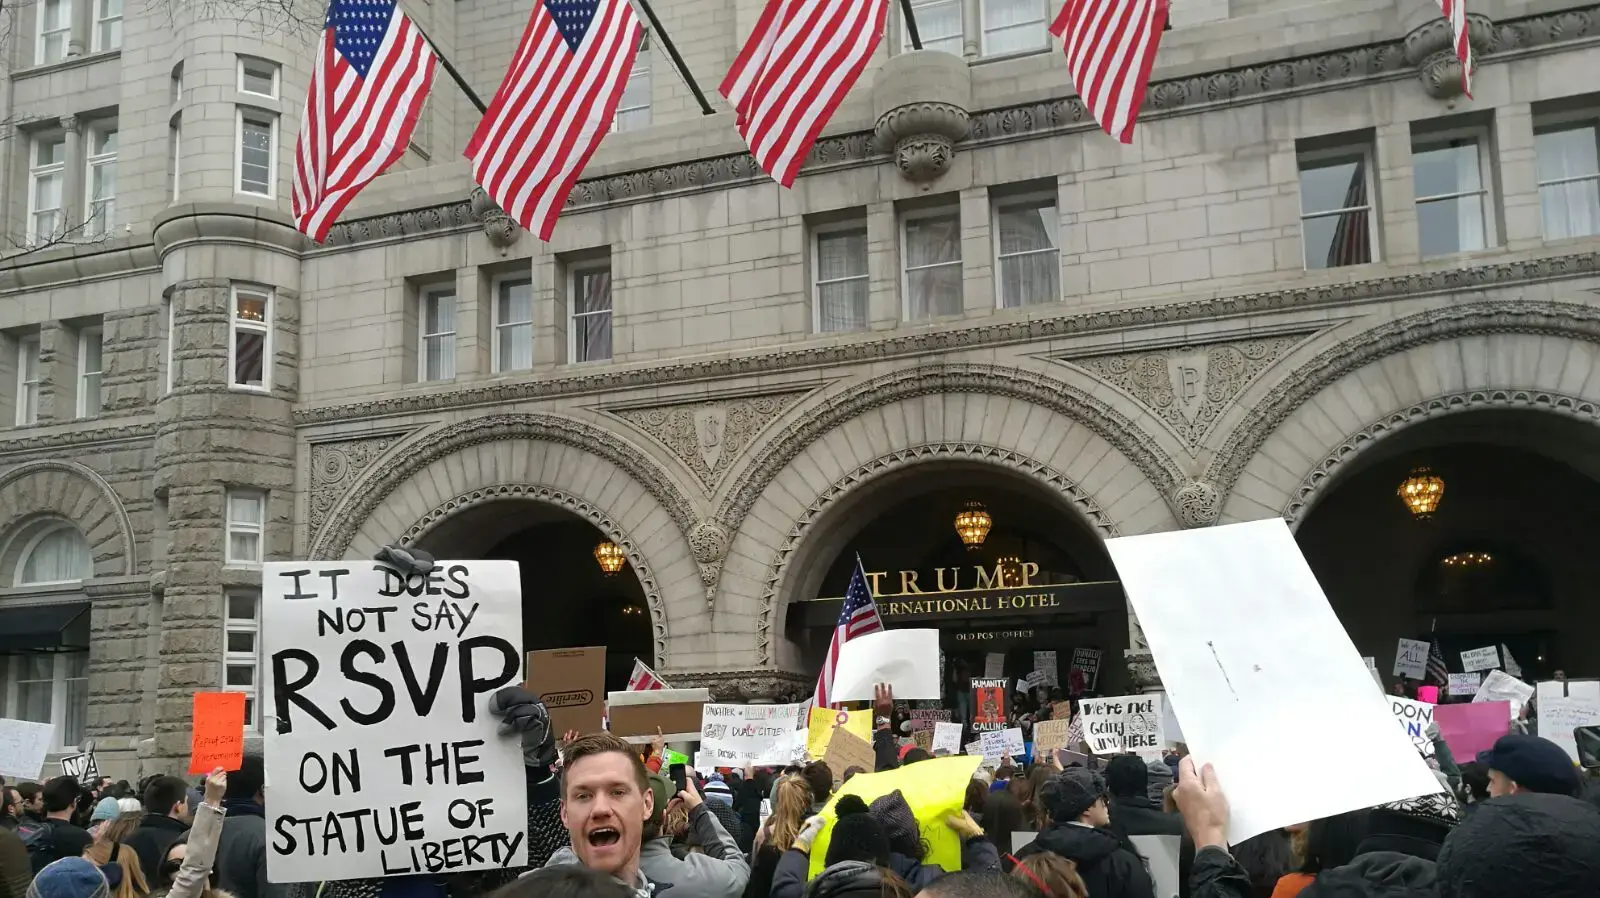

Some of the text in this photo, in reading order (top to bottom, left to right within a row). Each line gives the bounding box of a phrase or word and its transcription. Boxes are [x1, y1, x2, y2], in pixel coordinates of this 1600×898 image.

[278, 564, 470, 600] IT DOES
[865, 562, 1039, 598] TRUMP
[876, 593, 1060, 616] ERNATIONAL HOTEL
[318, 600, 480, 638] NOT SAY
[956, 633, 975, 641] OLD
[1400, 650, 1422, 663] ALL
[272, 635, 521, 735] RSVP
[971, 679, 1007, 689] HUMANITY
[546, 692, 588, 705] Sterilite
[1084, 702, 1123, 716] We're
[1128, 700, 1154, 714] not
[705, 705, 736, 717] DAUGHTER
[923, 720, 933, 728] IS
[972, 722, 1008, 731] CALLING
[1090, 718, 1125, 737] Going
[299, 739, 485, 795] ON THE
[272, 798, 494, 856] STATUE OF
[381, 831, 524, 875] LIBERTY
